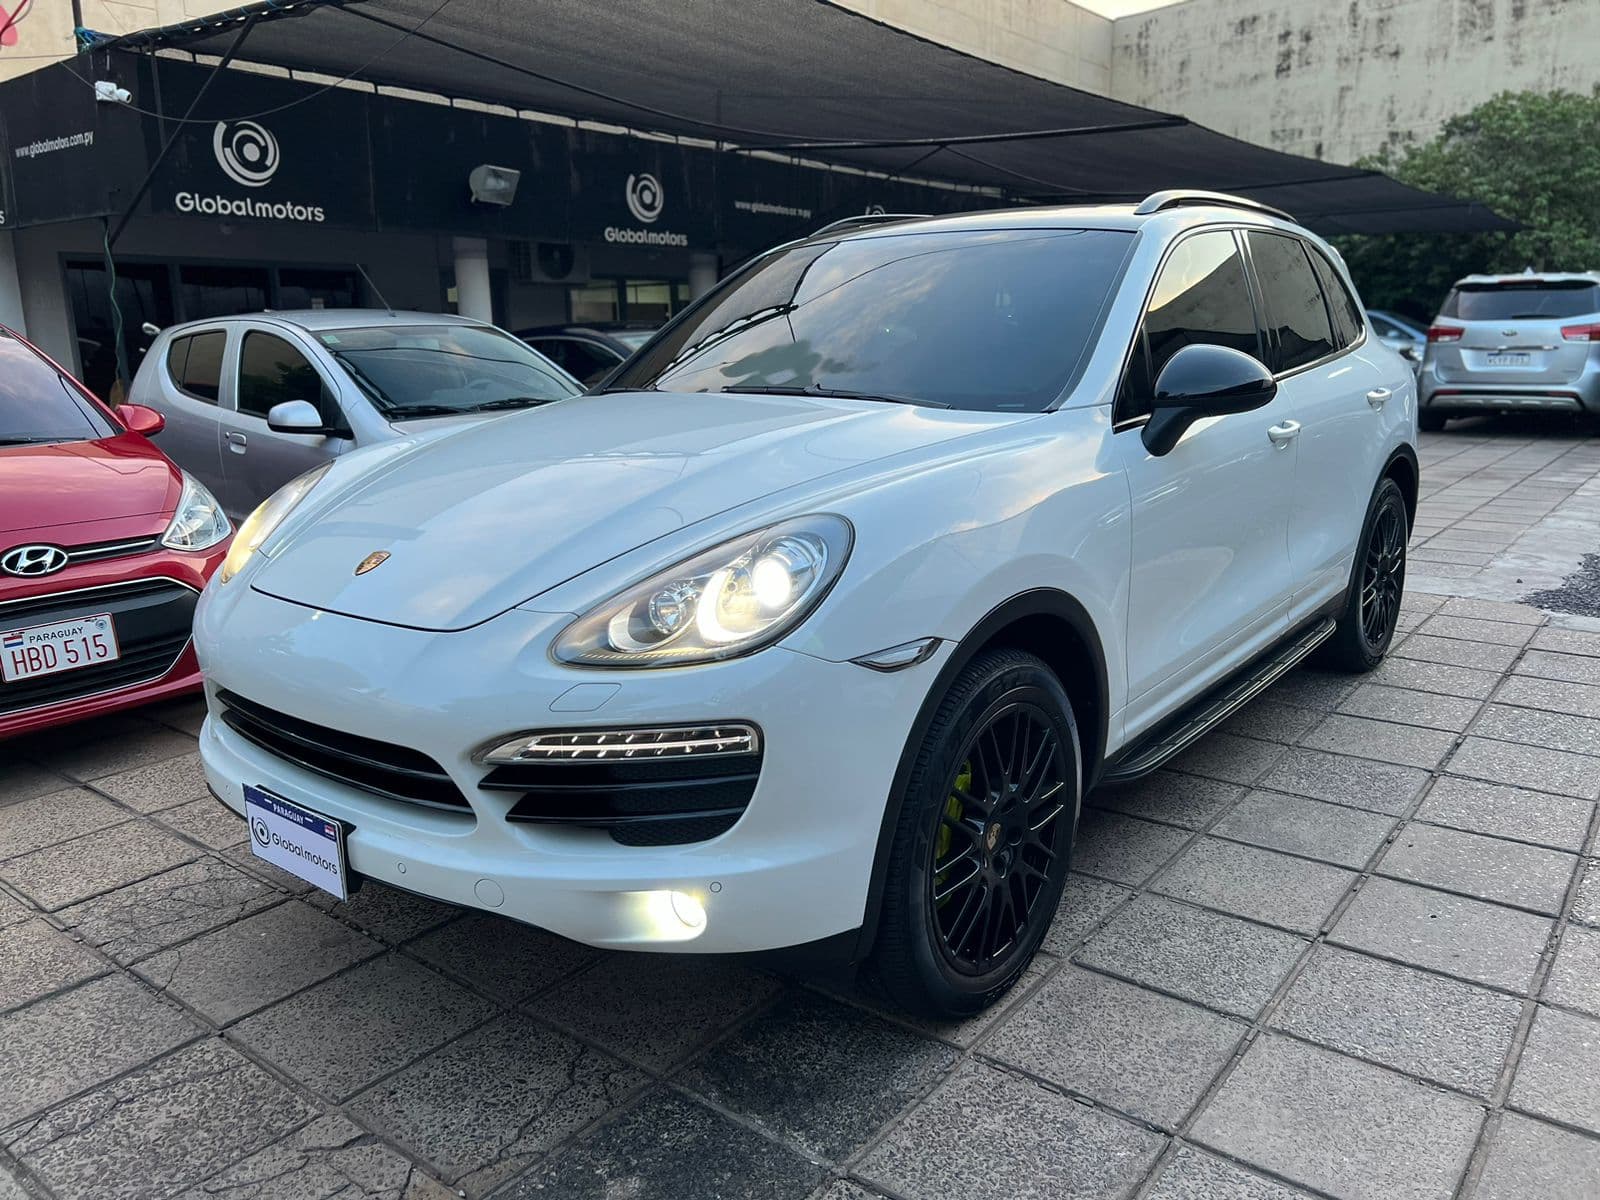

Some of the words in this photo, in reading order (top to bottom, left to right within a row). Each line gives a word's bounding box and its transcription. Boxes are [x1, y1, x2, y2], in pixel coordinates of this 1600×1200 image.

[15, 131, 94, 158] www.globalmotors.com.py
[175, 192, 325, 222] Globalmotors
[604, 226, 688, 246] Globalmotors
[29, 627, 84, 643] PARAGUAY
[11, 644, 57, 675] HBD
[64, 634, 108, 663] 515
[272, 803, 304, 824] PARAGUAY
[272, 832, 337, 874] Globalmotors
